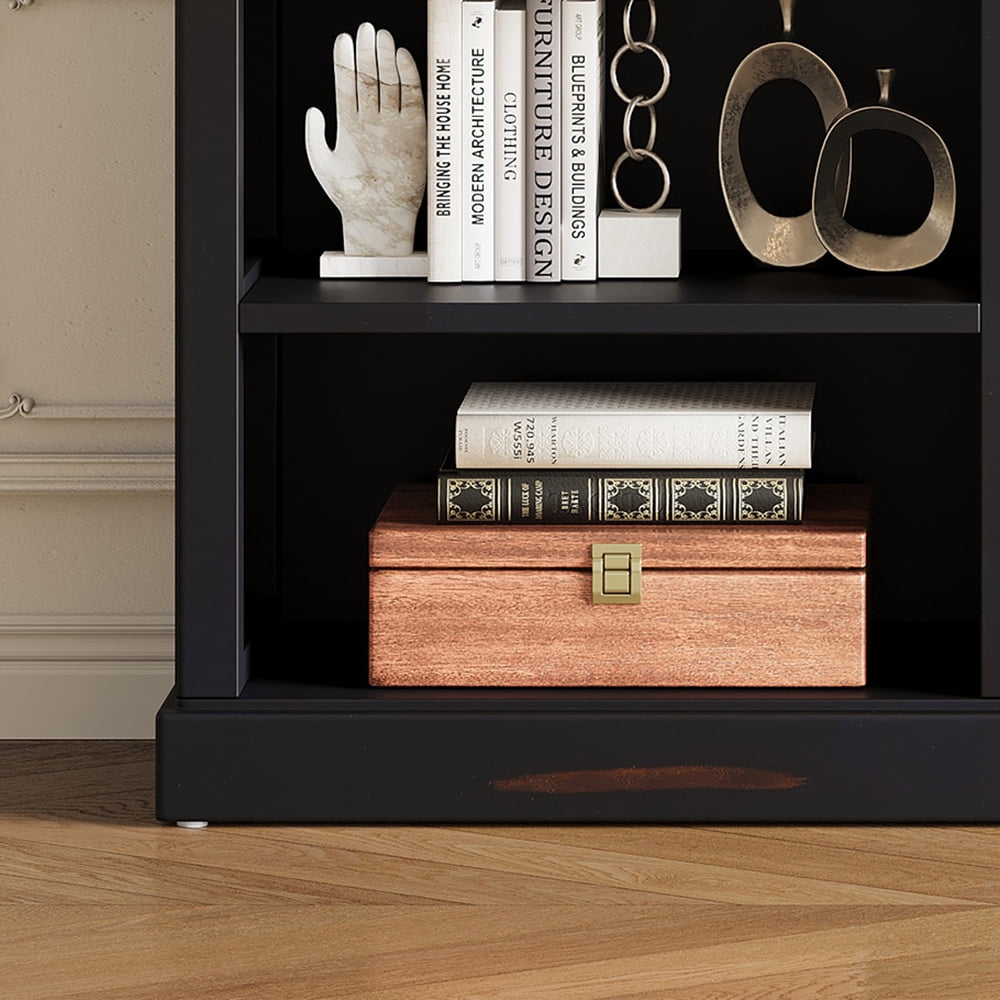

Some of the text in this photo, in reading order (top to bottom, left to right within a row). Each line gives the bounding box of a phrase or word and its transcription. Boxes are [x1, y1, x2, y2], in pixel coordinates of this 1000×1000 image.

[436, 58, 451, 216] BRINGING THE HOUSE HOME
[471, 48, 485, 225] MODERN ARCHITECTURE
[503, 92, 517, 180] CLOTHING
[571, 55, 585, 239] BLUEPRINTS & BUILDINGS
[534, 171, 553, 277] DESIGN
[513, 421, 522, 460] W555i
[526, 418, 535, 464] 720.945
[751, 415, 759, 433] ND
